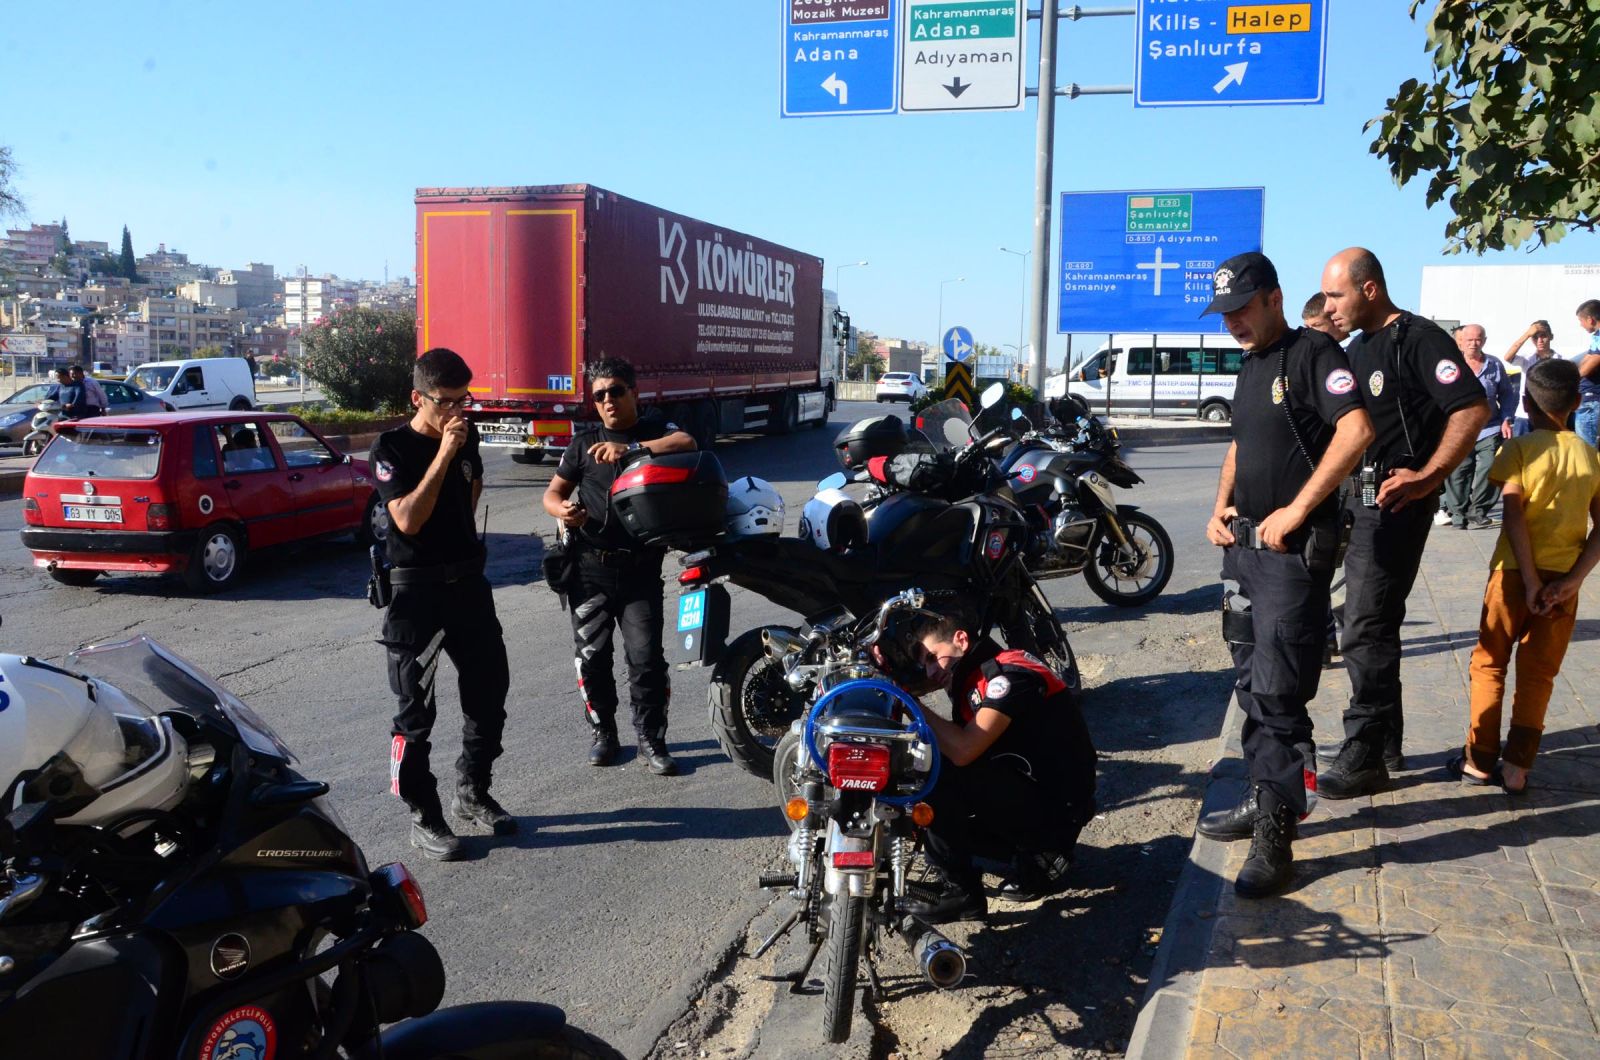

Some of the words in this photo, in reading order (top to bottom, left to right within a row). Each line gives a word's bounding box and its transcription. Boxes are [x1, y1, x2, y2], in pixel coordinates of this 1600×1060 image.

[914, 7, 1015, 20] Kahramanmaraş
[1149, 14, 1201, 32] Kilis
[1232, 11, 1302, 30] Halep
[794, 28, 889, 41] Kahramanmaraş
[914, 23, 981, 38] Adana
[794, 48, 859, 62] Adana
[1149, 38, 1262, 60] Şanlıurfa
[914, 51, 1014, 68] Adıyaman
[1129, 209, 1189, 221] Şanlıurfa
[1129, 220, 1189, 231] Osmaniye
[1158, 234, 1218, 245] Adıyaman
[696, 232, 795, 309] KÖMÜRLER
[1065, 271, 1148, 281] Kahramanmaraş
[1065, 282, 1117, 292] Osmaniye
[1184, 282, 1211, 291] Kilis
[549, 376, 573, 390] TIR
[86, 508, 96, 519] YY
[840, 779, 877, 790] YARGIC
[257, 849, 343, 858] CROSSTOURER
